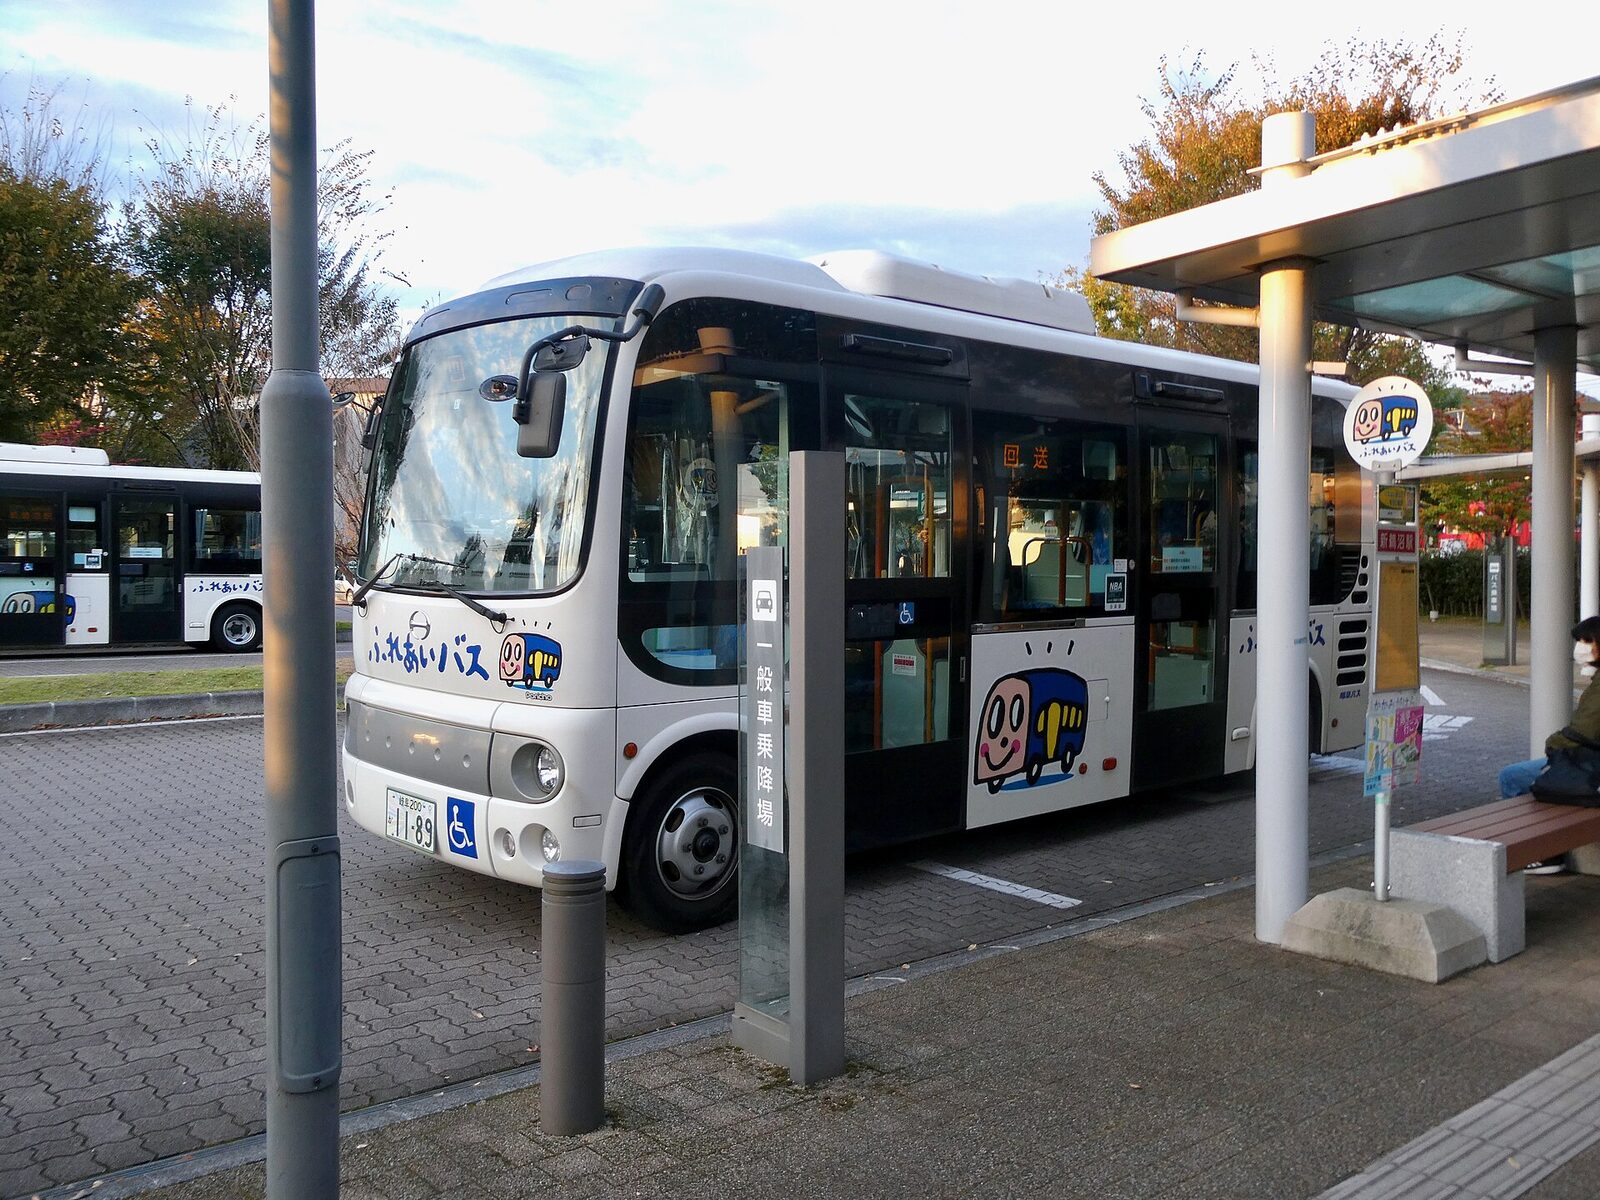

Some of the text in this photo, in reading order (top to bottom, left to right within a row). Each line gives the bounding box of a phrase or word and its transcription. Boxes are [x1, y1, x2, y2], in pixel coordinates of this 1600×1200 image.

[1004, 444, 1049, 469] 回送
[1360, 442, 1416, 458] ふれあいバス
[369, 626, 490, 681] ふれあいバス
[756, 641, 773, 827] 一般車乗降場
